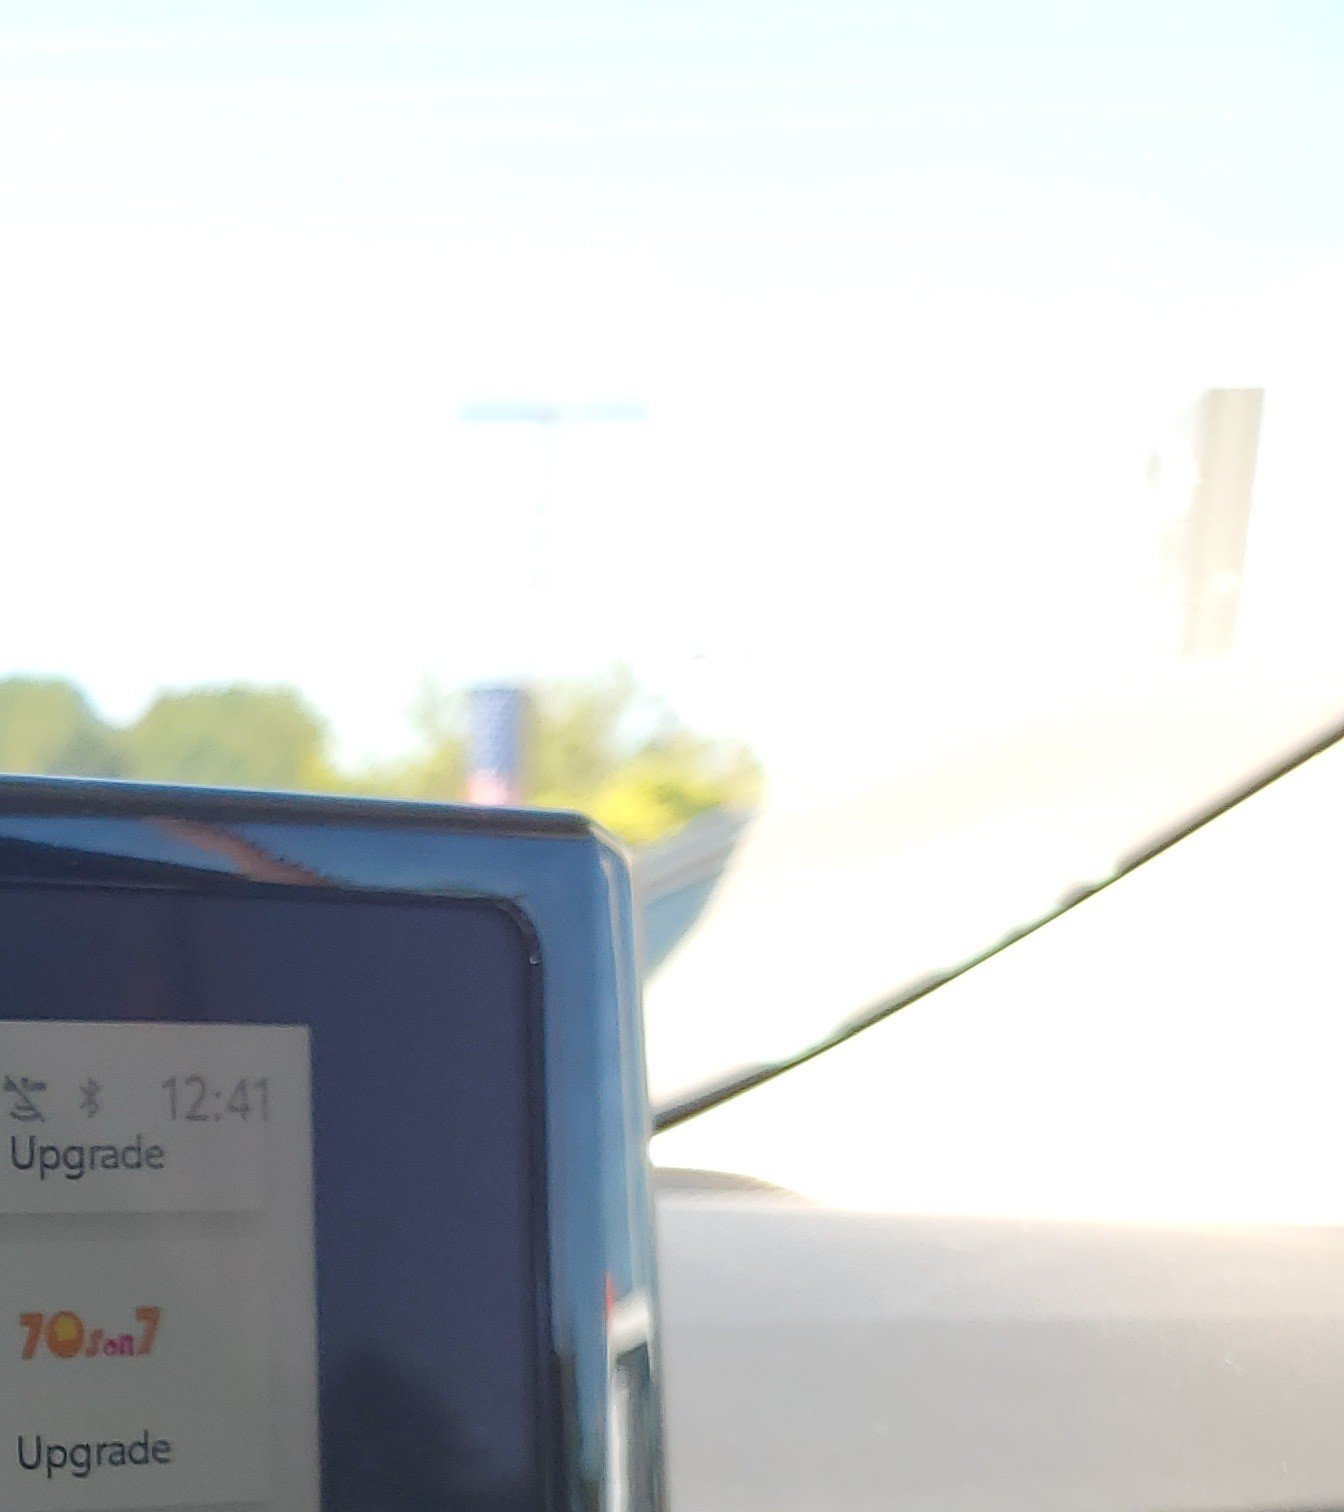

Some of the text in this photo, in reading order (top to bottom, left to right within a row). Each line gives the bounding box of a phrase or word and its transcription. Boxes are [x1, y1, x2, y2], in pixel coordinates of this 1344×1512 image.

[161, 1074, 270, 1122] 12:41
[9, 1134, 166, 1181] Upgrade
[16, 1430, 173, 1480] Upgrade
